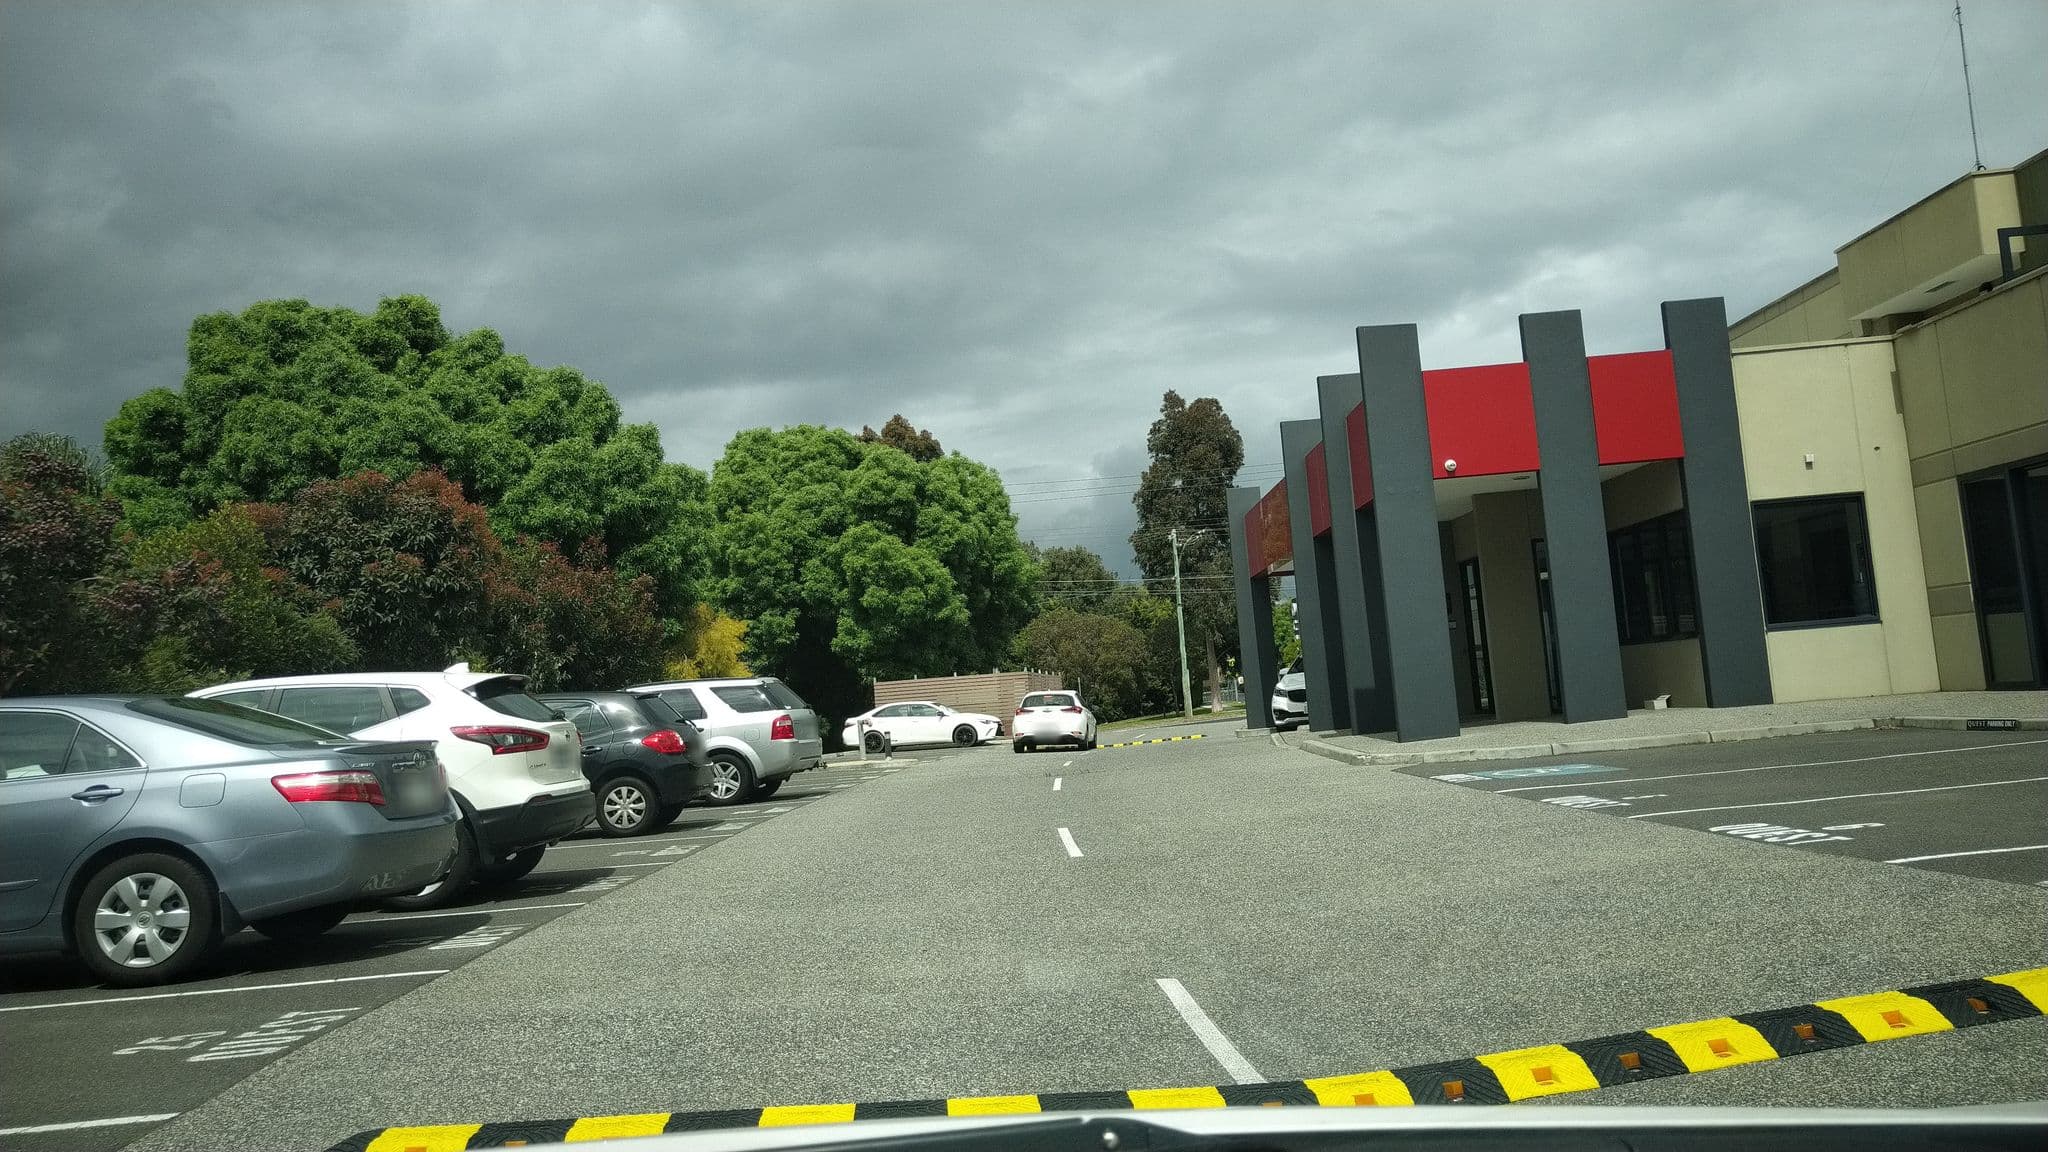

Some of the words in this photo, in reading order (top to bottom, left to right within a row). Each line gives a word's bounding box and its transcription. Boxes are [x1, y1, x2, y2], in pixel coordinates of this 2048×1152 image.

[1967, 720, 1986, 728] QUEST
[1708, 822, 1854, 845] QUEST
[427, 923, 533, 950] QUEST
[111, 1030, 228, 1055] 25
[185, 1007, 364, 1062] QUEST
